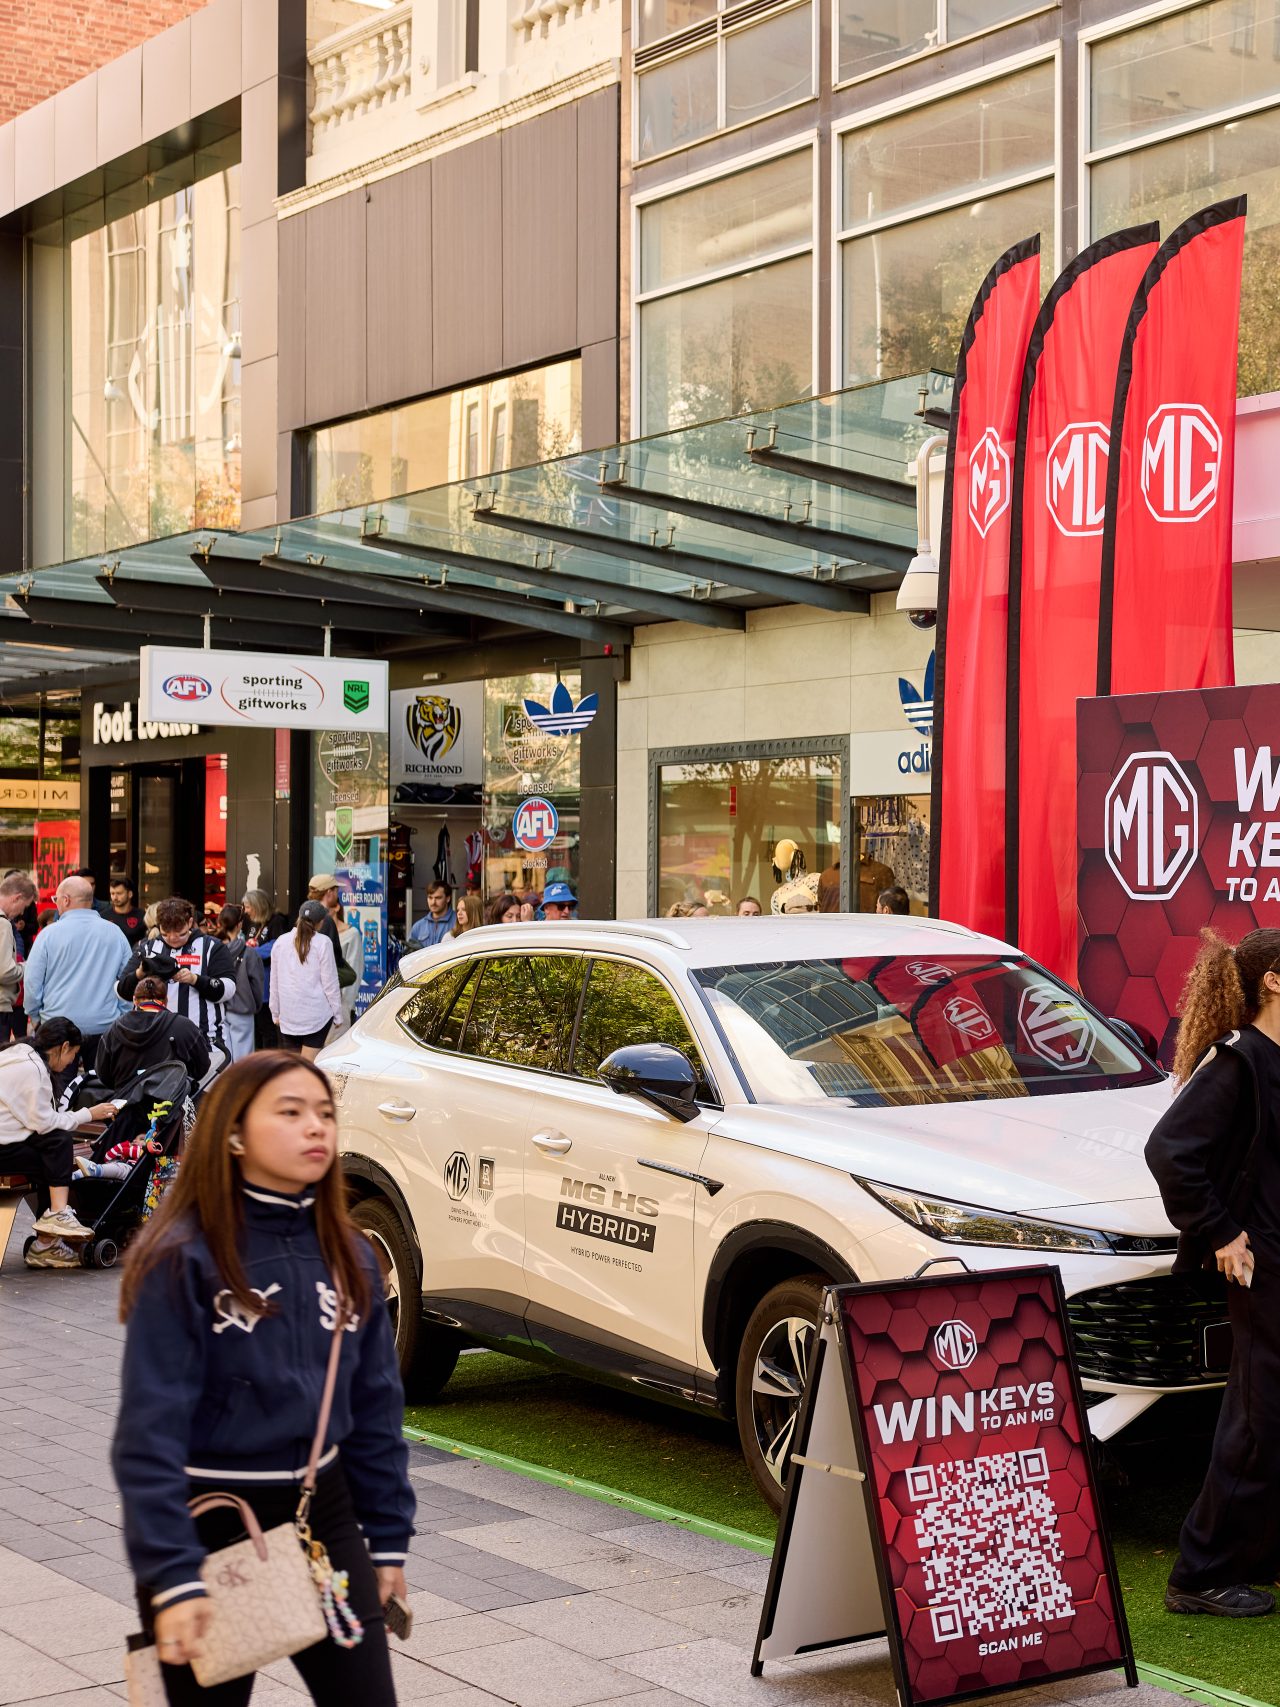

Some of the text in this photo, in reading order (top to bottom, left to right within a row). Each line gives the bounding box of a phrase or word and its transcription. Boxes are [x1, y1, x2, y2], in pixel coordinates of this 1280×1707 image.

[1145, 414, 1218, 512] MG
[166, 680, 209, 697] AFL
[242, 674, 303, 690] sporting
[346, 683, 367, 694] NRL
[238, 696, 307, 711] giftworks
[93, 701, 133, 745] Foot
[328, 731, 361, 745] sporting
[326, 757, 363, 774] giftworks
[512, 744, 558, 764] giftworks
[897, 743, 932, 774] adi
[404, 763, 463, 775] RICHMOND
[330, 790, 360, 804] licensed
[517, 780, 554, 794] licensed
[516, 810, 556, 839] AFL
[1112, 765, 1190, 887] MG
[522, 858, 548, 869] stockist
[341, 892, 384, 904] GATHER ROUND
[1226, 877, 1257, 901] TO
[446, 1155, 469, 1197] MG
[606, 1174, 616, 1182] NEW
[559, 1177, 660, 1218] MG HS
[561, 1207, 651, 1244] HYBRID+
[571, 1246, 643, 1273] HYBRID POWER PERFECTED
[937, 1323, 974, 1366] MG
[873, 1381, 1055, 1445] WIN KEYS
[981, 1407, 1055, 1430] TO AN MG
[978, 1632, 1043, 1657] SCAN ME
